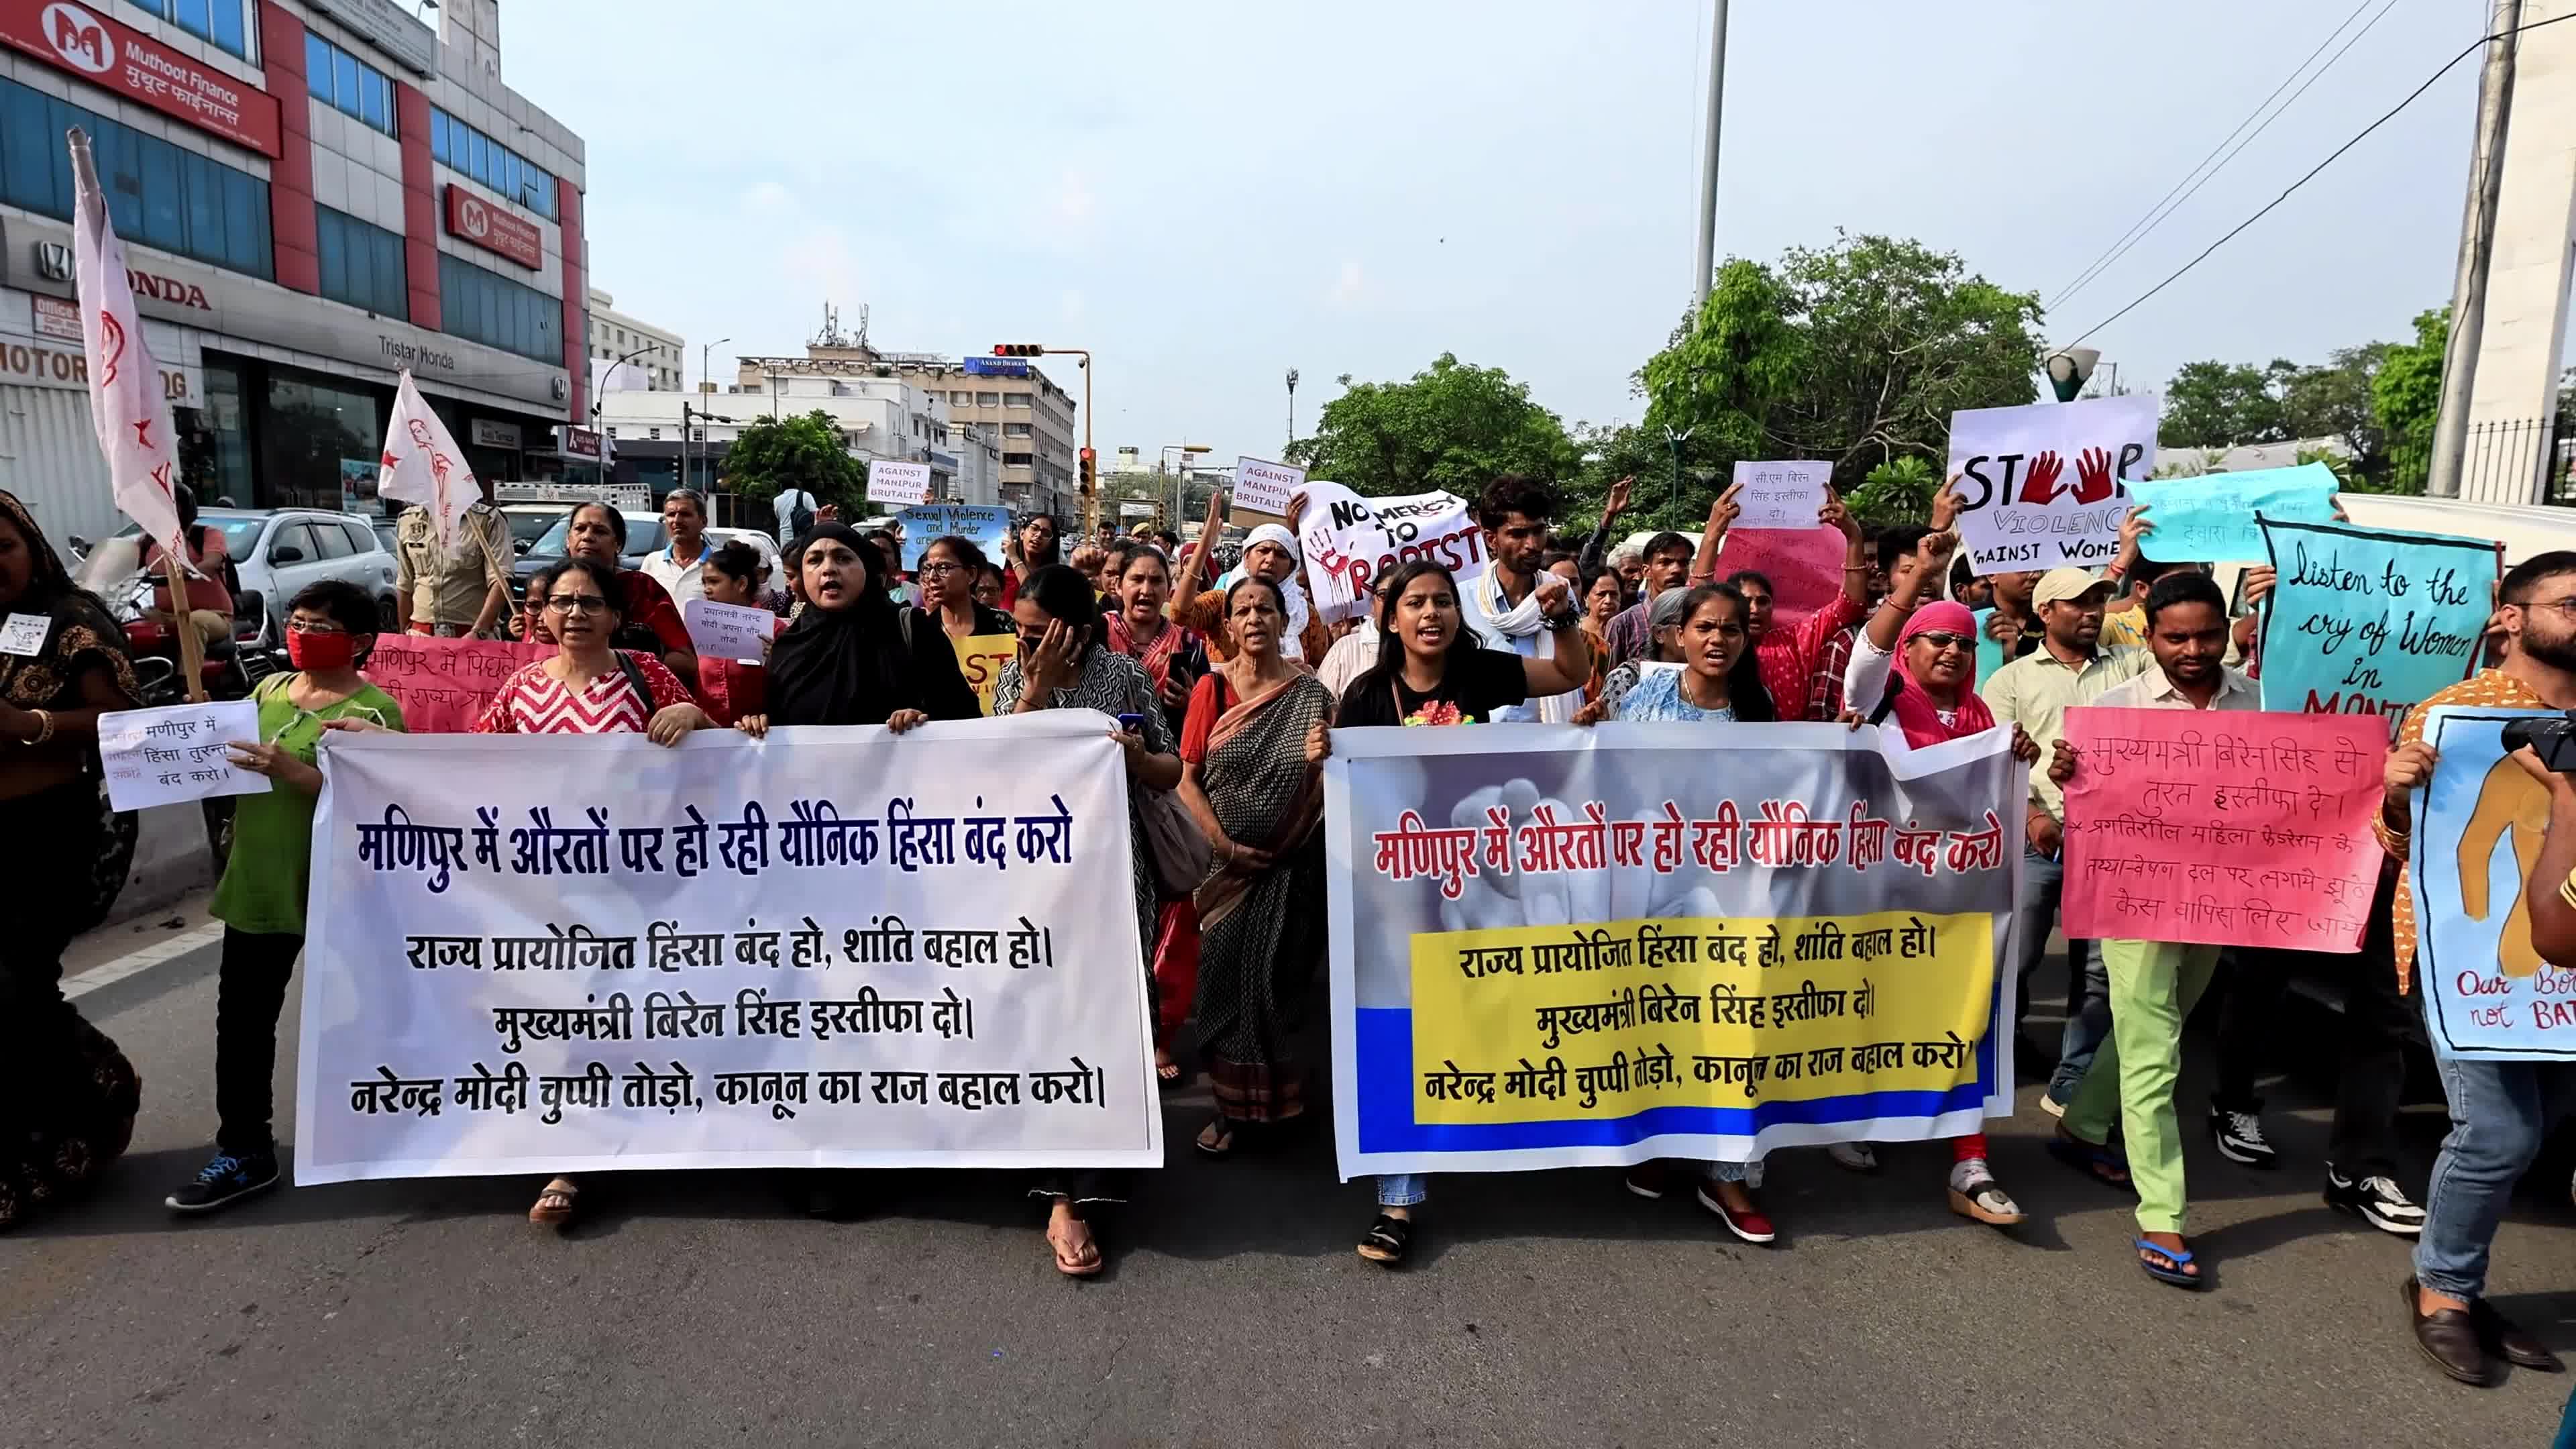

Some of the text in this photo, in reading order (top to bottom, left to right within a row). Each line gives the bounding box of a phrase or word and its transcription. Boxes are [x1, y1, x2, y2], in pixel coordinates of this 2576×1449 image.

[124, 64, 169, 98] मुथूट
[125, 40, 239, 107] Muthoot Finance
[125, 268, 212, 311] NDA
[0, 343, 88, 383] OTOR
[379, 335, 454, 370] Tristar Honda
[877, 478, 922, 489] MANIPUR
[878, 467, 922, 478] AGAINST
[1243, 480, 1290, 497] MANIPU
[1246, 467, 1294, 484] AGAINST
[906, 508, 995, 521] Sexual Violence
[926, 522, 981, 535] and Murder
[1330, 494, 1456, 531] NO MERCY
[1993, 506, 2135, 535] VIOLENC
[1375, 522, 1418, 548] TO
[2058, 538, 2121, 559] WOME
[2289, 540, 2469, 606] listen to the
[2298, 608, 2471, 657] cry of Women
[2342, 657, 2381, 690] in
[204, 716, 216, 731] में
[144, 747, 180, 763] हिंसा
[2334, 735, 2369, 777] से
[157, 771, 182, 786] बंद
[2214, 777, 2300, 815] इस्तीफा
[356, 794, 1073, 893] मणिपुर में औरतों पर हो रही यौनिक हिंसा बंद करो
[1374, 800, 2002, 898] मणिपुर में औरतों पर हो रही यौनिक हिंसा बंद करो
[2192, 820, 2256, 845] महिला
[2330, 833, 2369, 854] के
[2188, 864, 2220, 884] दल
[2224, 867, 2254, 888] पर
[2109, 888, 2166, 921] केस
[2241, 898, 2302, 936] लिए
[406, 936, 482, 969] राज्य
[492, 922, 637, 971] प्रायोजित
[647, 920, 724, 972] हिंसा
[734, 917, 781, 969] बंद
[790, 916, 831, 971] हो,
[843, 915, 914, 964] शांति
[922, 929, 998, 969] बहाल
[1460, 947, 1524, 978] राज्य
[1532, 930, 1631, 975] प्रायोजित
[1639, 924, 1698, 968] हिंसा
[1707, 922, 1747, 967] बंद
[1756, 924, 1785, 969] हो,
[1794, 921, 1845, 961] शांति
[1851, 928, 1892, 961] बहाल
[2457, 971, 2514, 996] Our
[493, 992, 633, 1054] मुख्यमंत्री
[643, 989, 725, 1038] बिरेन
[736, 987, 801, 1038] सिंह
[810, 985, 923, 1040] इस्तीफा
[1536, 987, 1635, 1049] मुख्यमंत्री
[1639, 983, 1701, 1024] बिरेन
[1710, 983, 1766, 1028] सिंह
[1772, 979, 1846, 1029] इस्तीफा
[2470, 1000, 2514, 1028] not
[351, 1066, 443, 1117] नरेन्द्र
[454, 1061, 530, 1114] मोदी
[539, 1061, 612, 1124] चुप्पी
[714, 1071, 808, 1119] कानून
[818, 1071, 862, 1105] का
[871, 1071, 928, 1105] राज
[937, 1073, 1020, 1110] बहाल
[1424, 1060, 1496, 1104] नरेन्द्र
[1504, 1056, 1567, 1101] मोदी
[1576, 1051, 1629, 1109] चुप्पी
[1692, 1055, 1770, 1098] कानून
[1774, 1052, 1803, 1080] का
[1808, 1047, 1845, 1076] राज
[1851, 1042, 1904, 1073] बहाल
